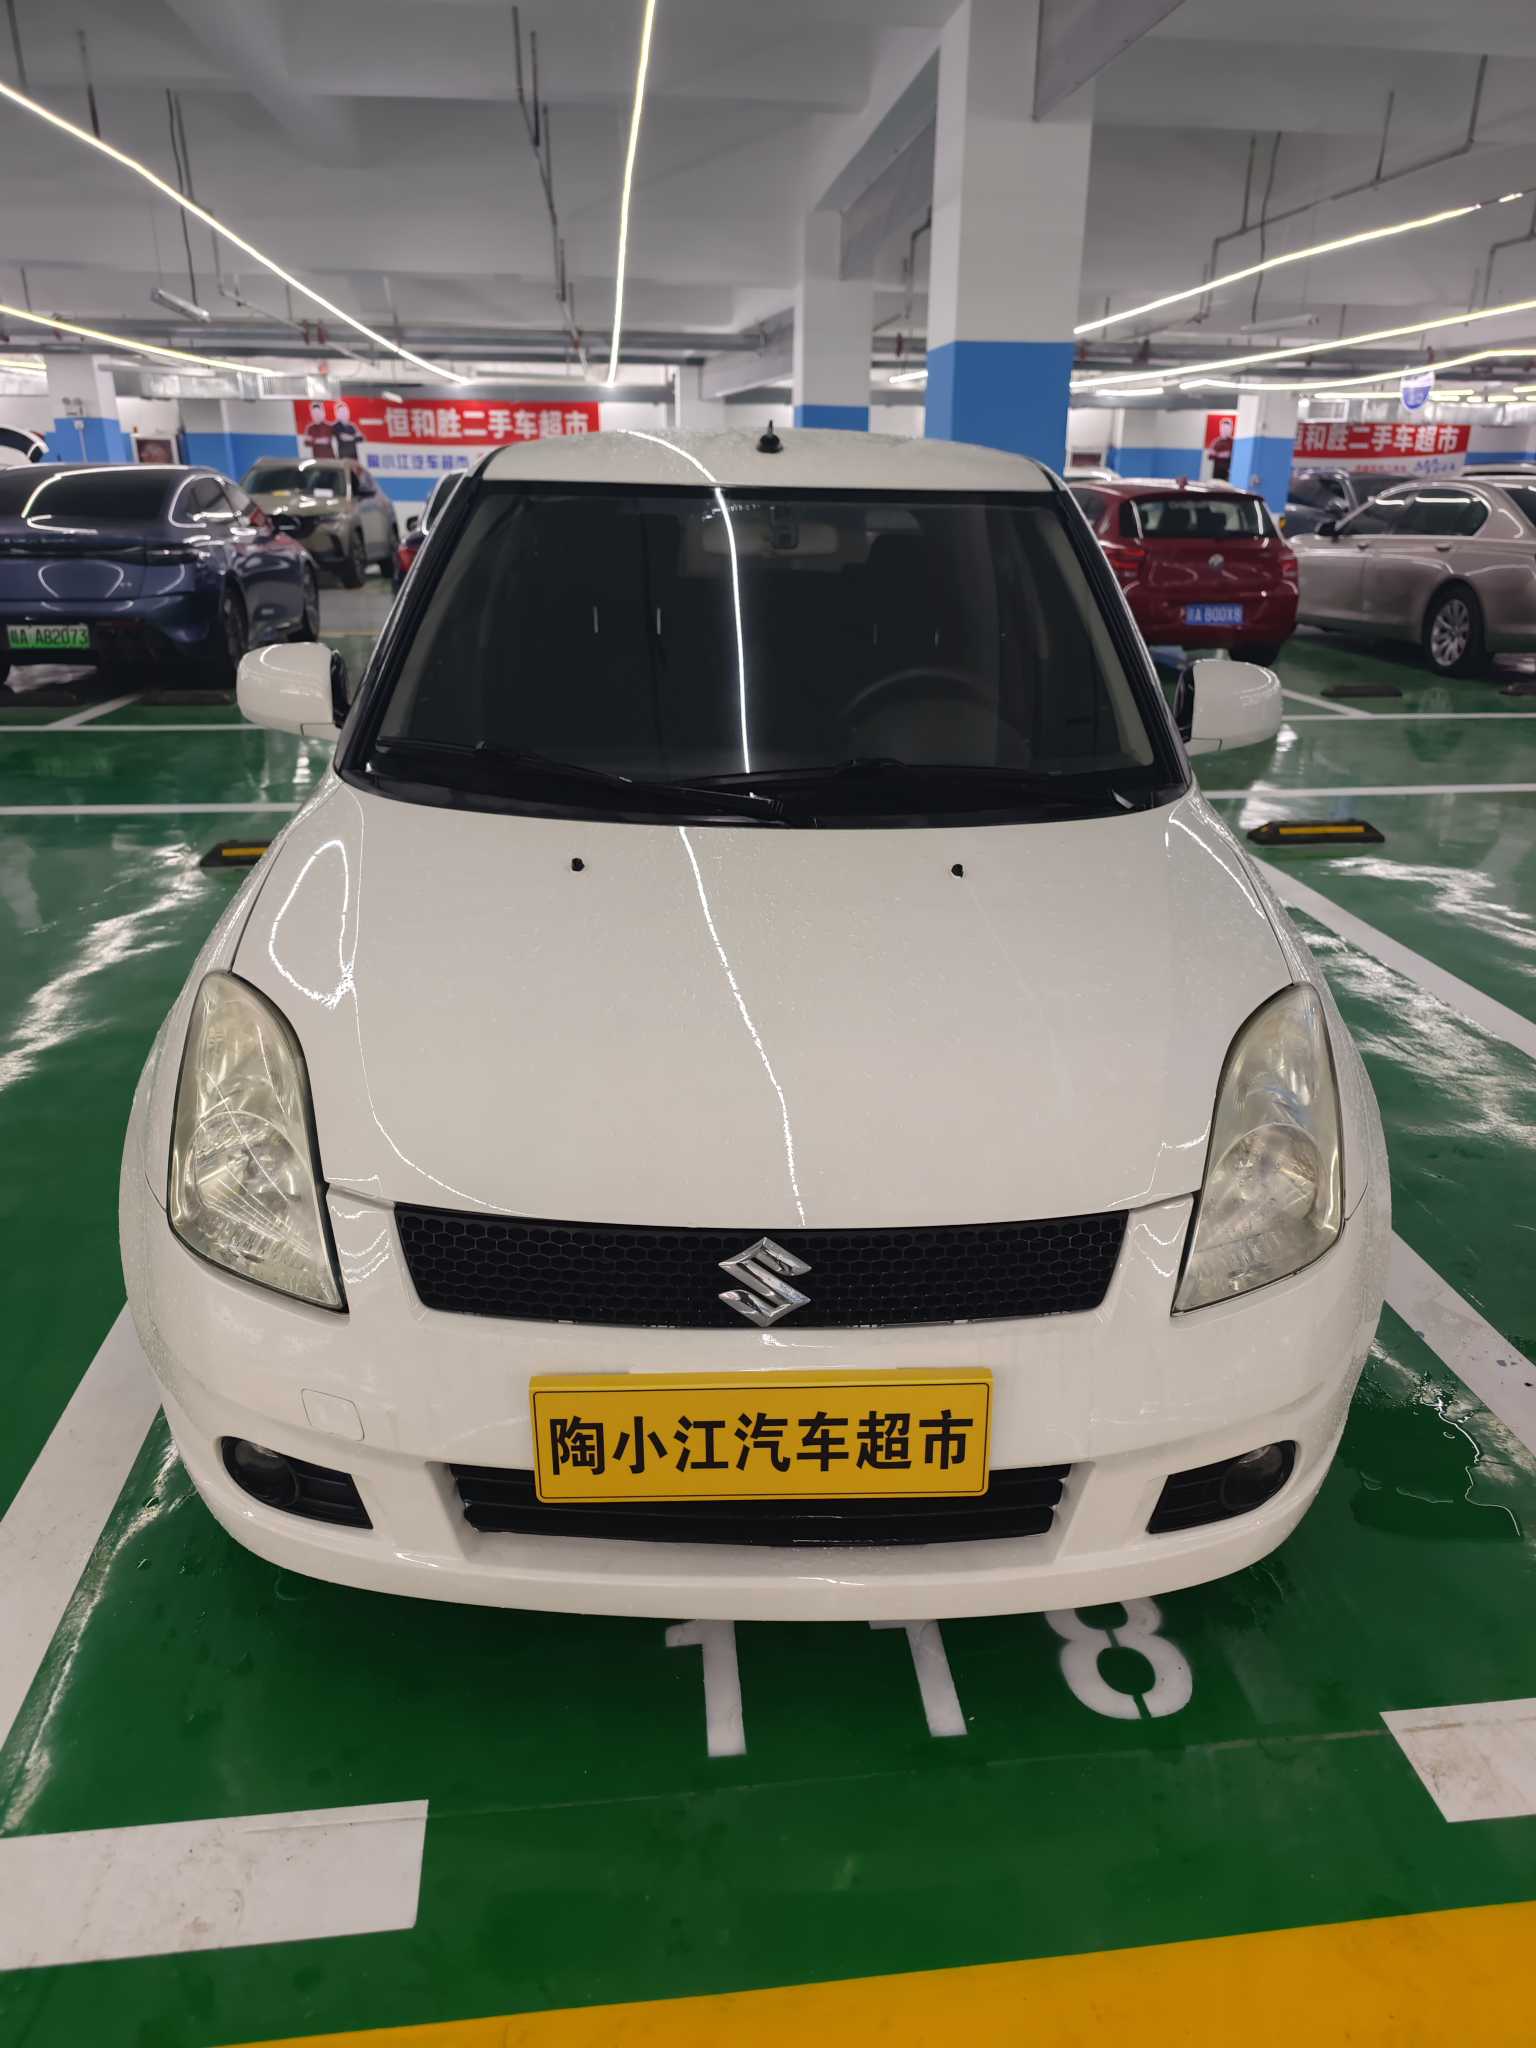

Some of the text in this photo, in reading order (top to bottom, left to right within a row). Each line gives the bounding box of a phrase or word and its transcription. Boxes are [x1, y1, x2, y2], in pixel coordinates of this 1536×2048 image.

[549, 1409, 975, 1475] 陶小江汽车超市
